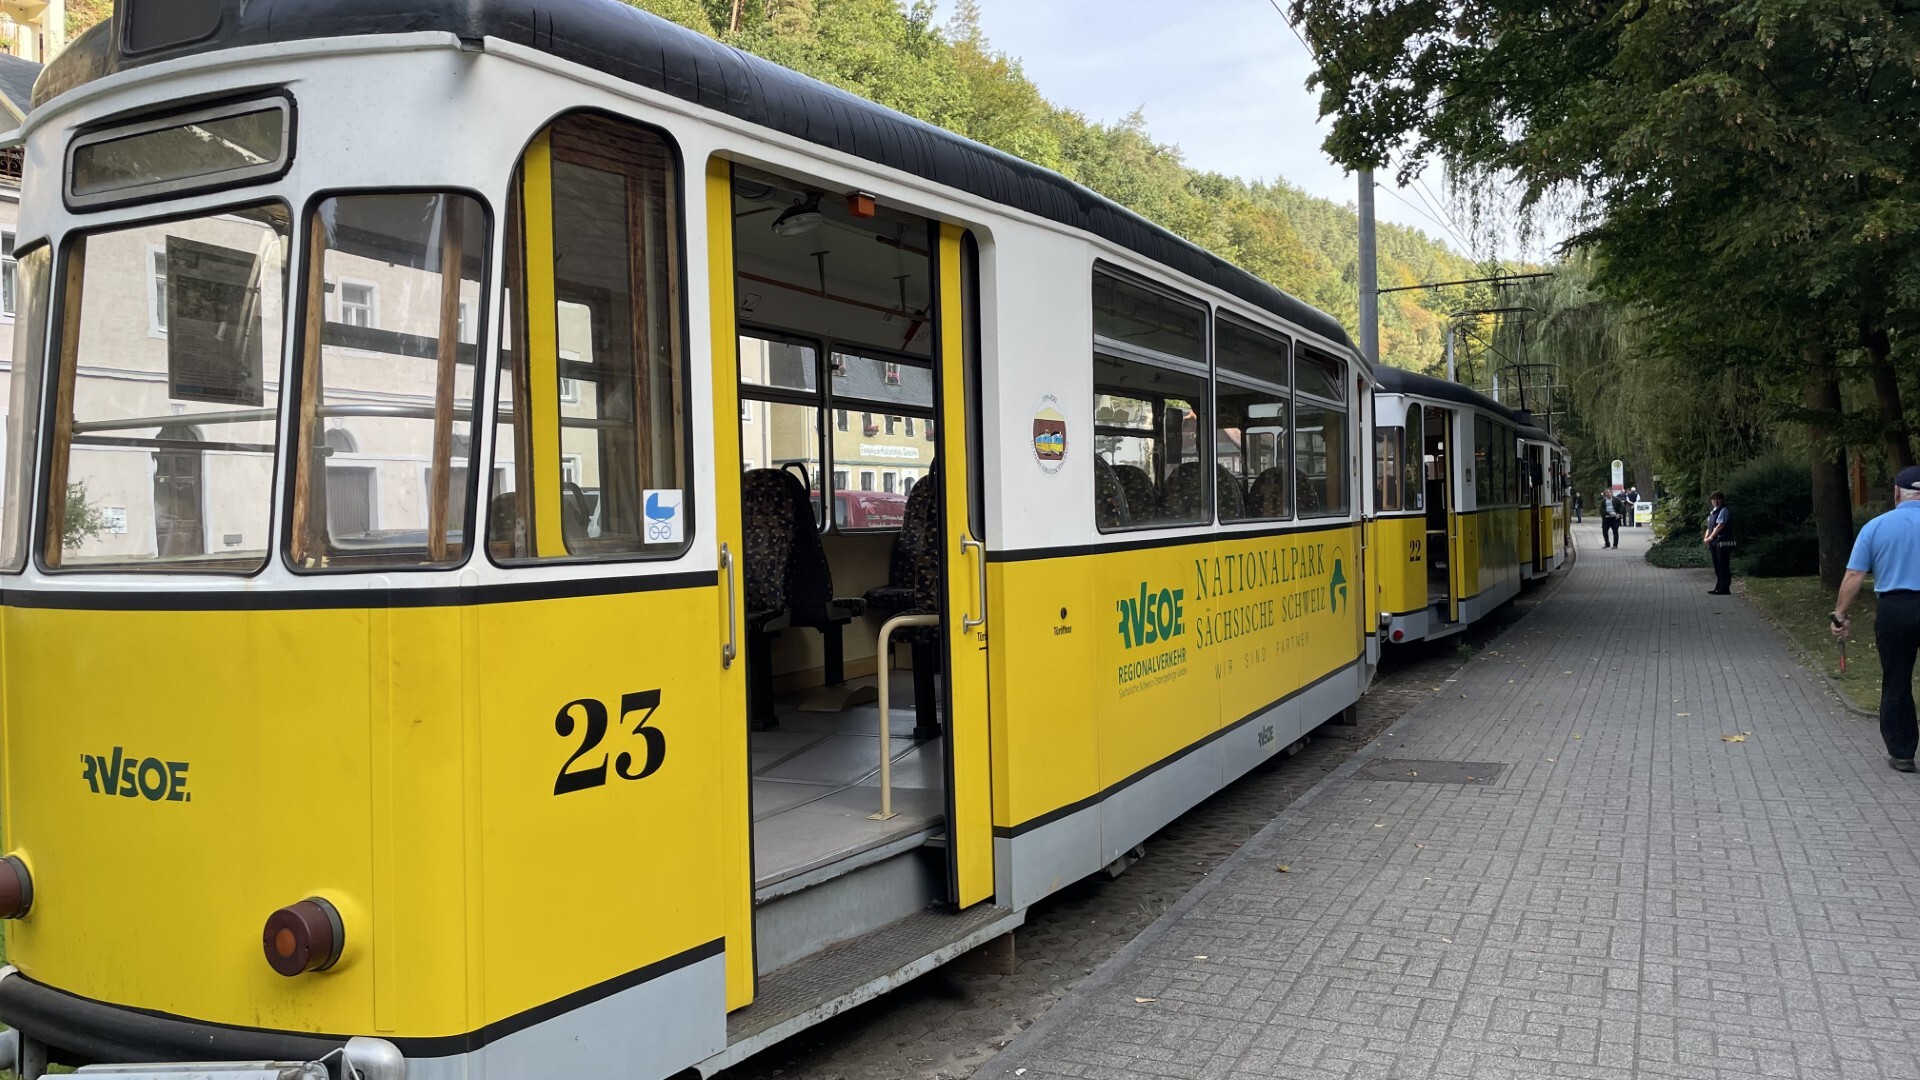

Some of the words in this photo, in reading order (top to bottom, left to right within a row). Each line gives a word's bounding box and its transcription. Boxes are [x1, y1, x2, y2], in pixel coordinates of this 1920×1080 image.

[1195, 544, 1325, 601] NATIONALPARK
[1409, 539, 1421, 562] 22
[1196, 600, 1274, 649] SÄCHSISCHE
[1282, 586, 1326, 623] SCHWEIZ
[1118, 647, 1187, 685] REGIONALVERKEHR
[1214, 659, 1233, 680] WIR
[1244, 646, 1267, 669] SIND
[1276, 631, 1309, 656] PARTNER
[553, 688, 667, 796] 23
